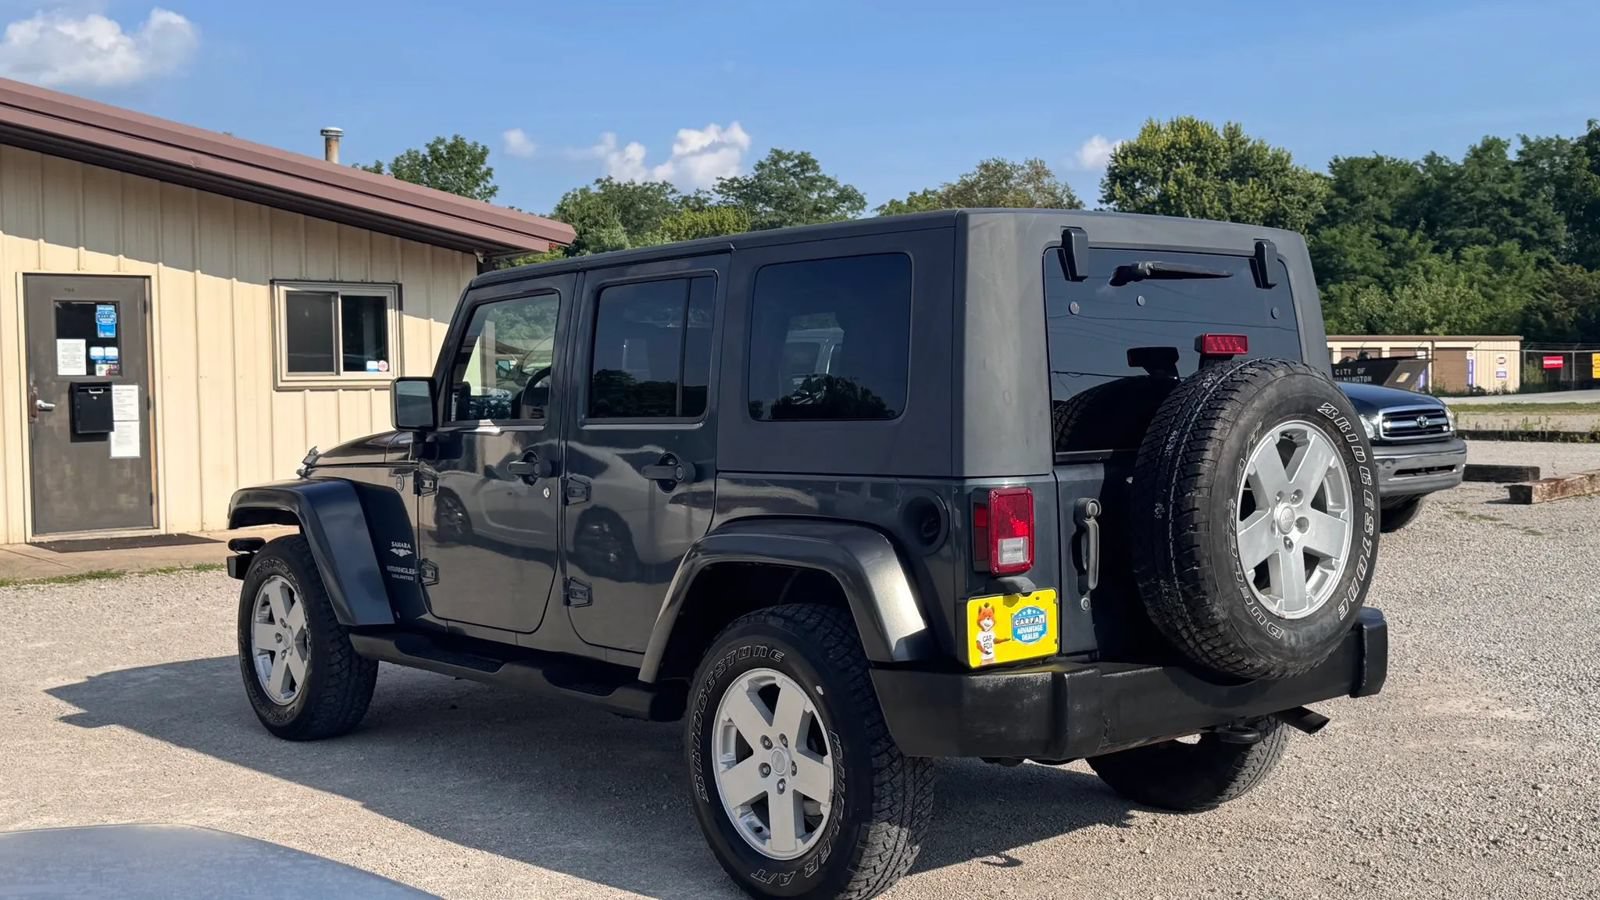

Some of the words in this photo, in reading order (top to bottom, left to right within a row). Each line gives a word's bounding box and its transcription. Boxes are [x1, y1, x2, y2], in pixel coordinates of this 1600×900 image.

[1334, 368, 1351, 376] CITY
[1357, 367, 1366, 375] OF
[391, 540, 411, 549] SAHARA
[1316, 402, 1374, 621] BRIDGESTONE
[691, 645, 785, 803] BRIDGESTONE
